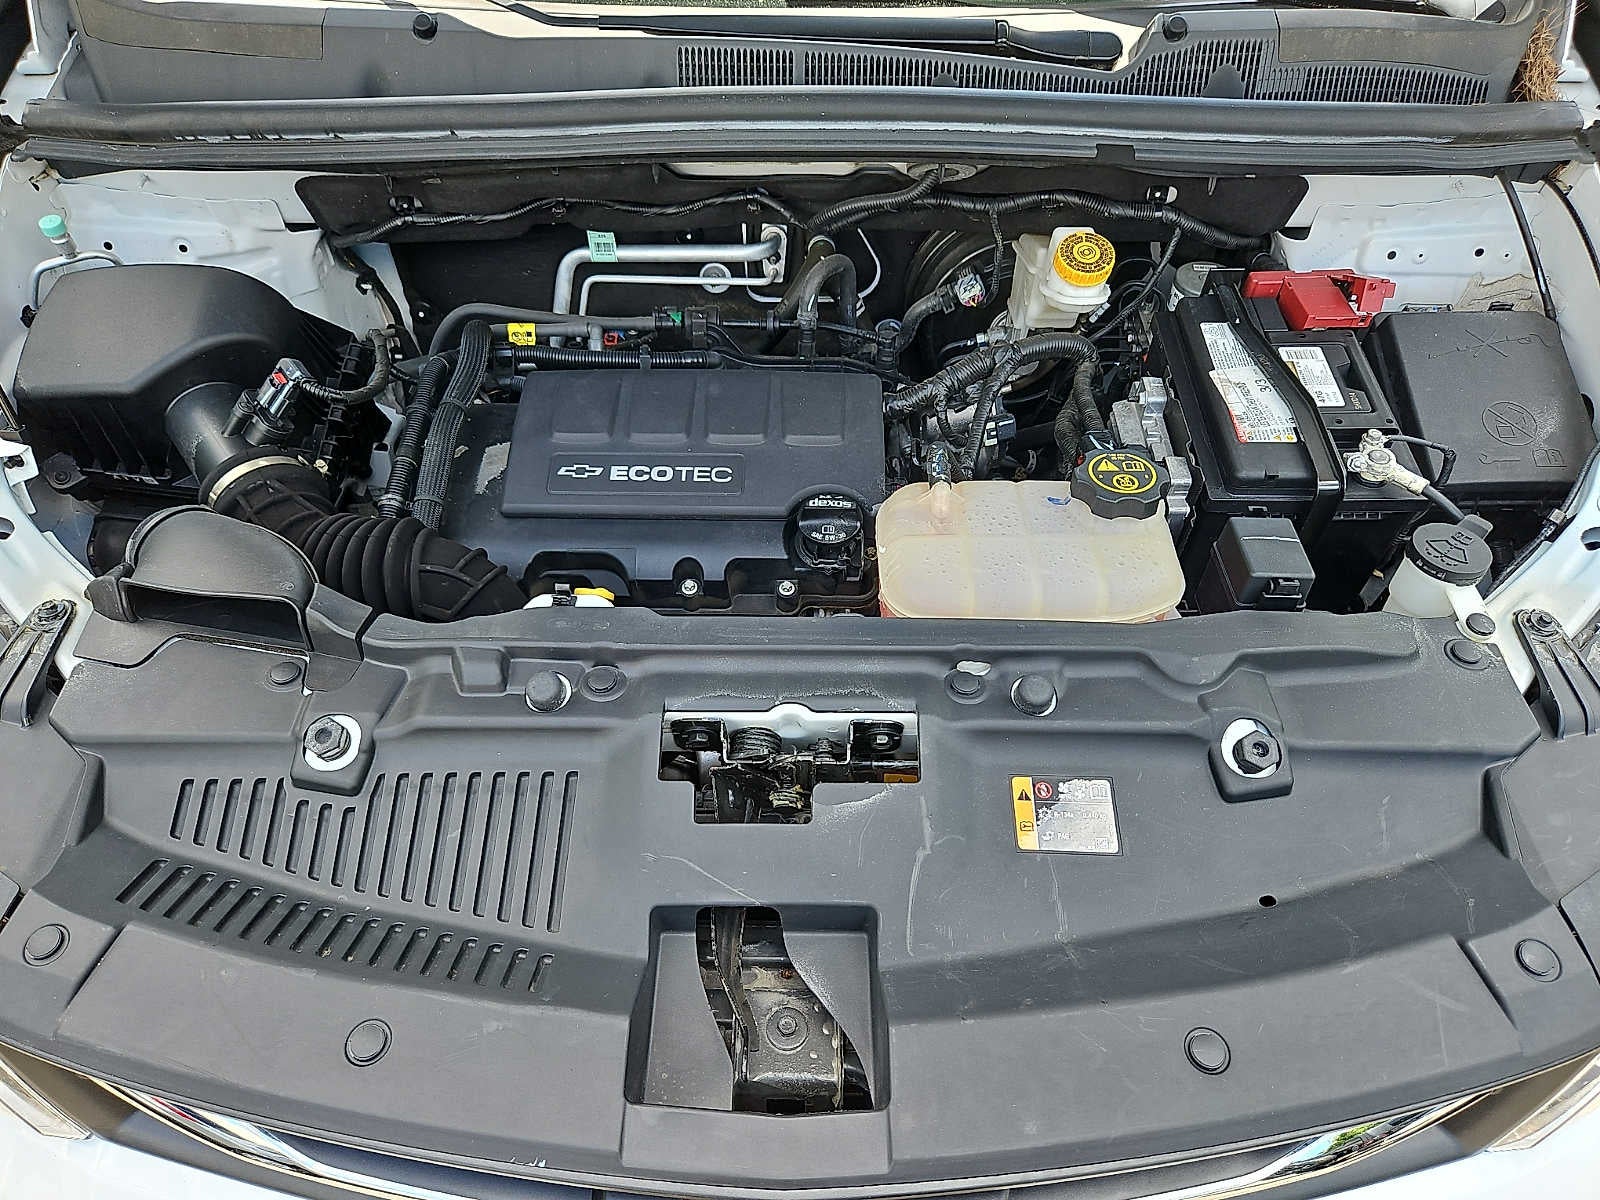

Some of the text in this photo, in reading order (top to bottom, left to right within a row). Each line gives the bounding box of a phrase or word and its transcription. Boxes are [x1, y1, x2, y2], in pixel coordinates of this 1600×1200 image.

[609, 465, 733, 483] ECOTEC
[808, 497, 853, 508] dexos
[810, 531, 824, 540] SAE
